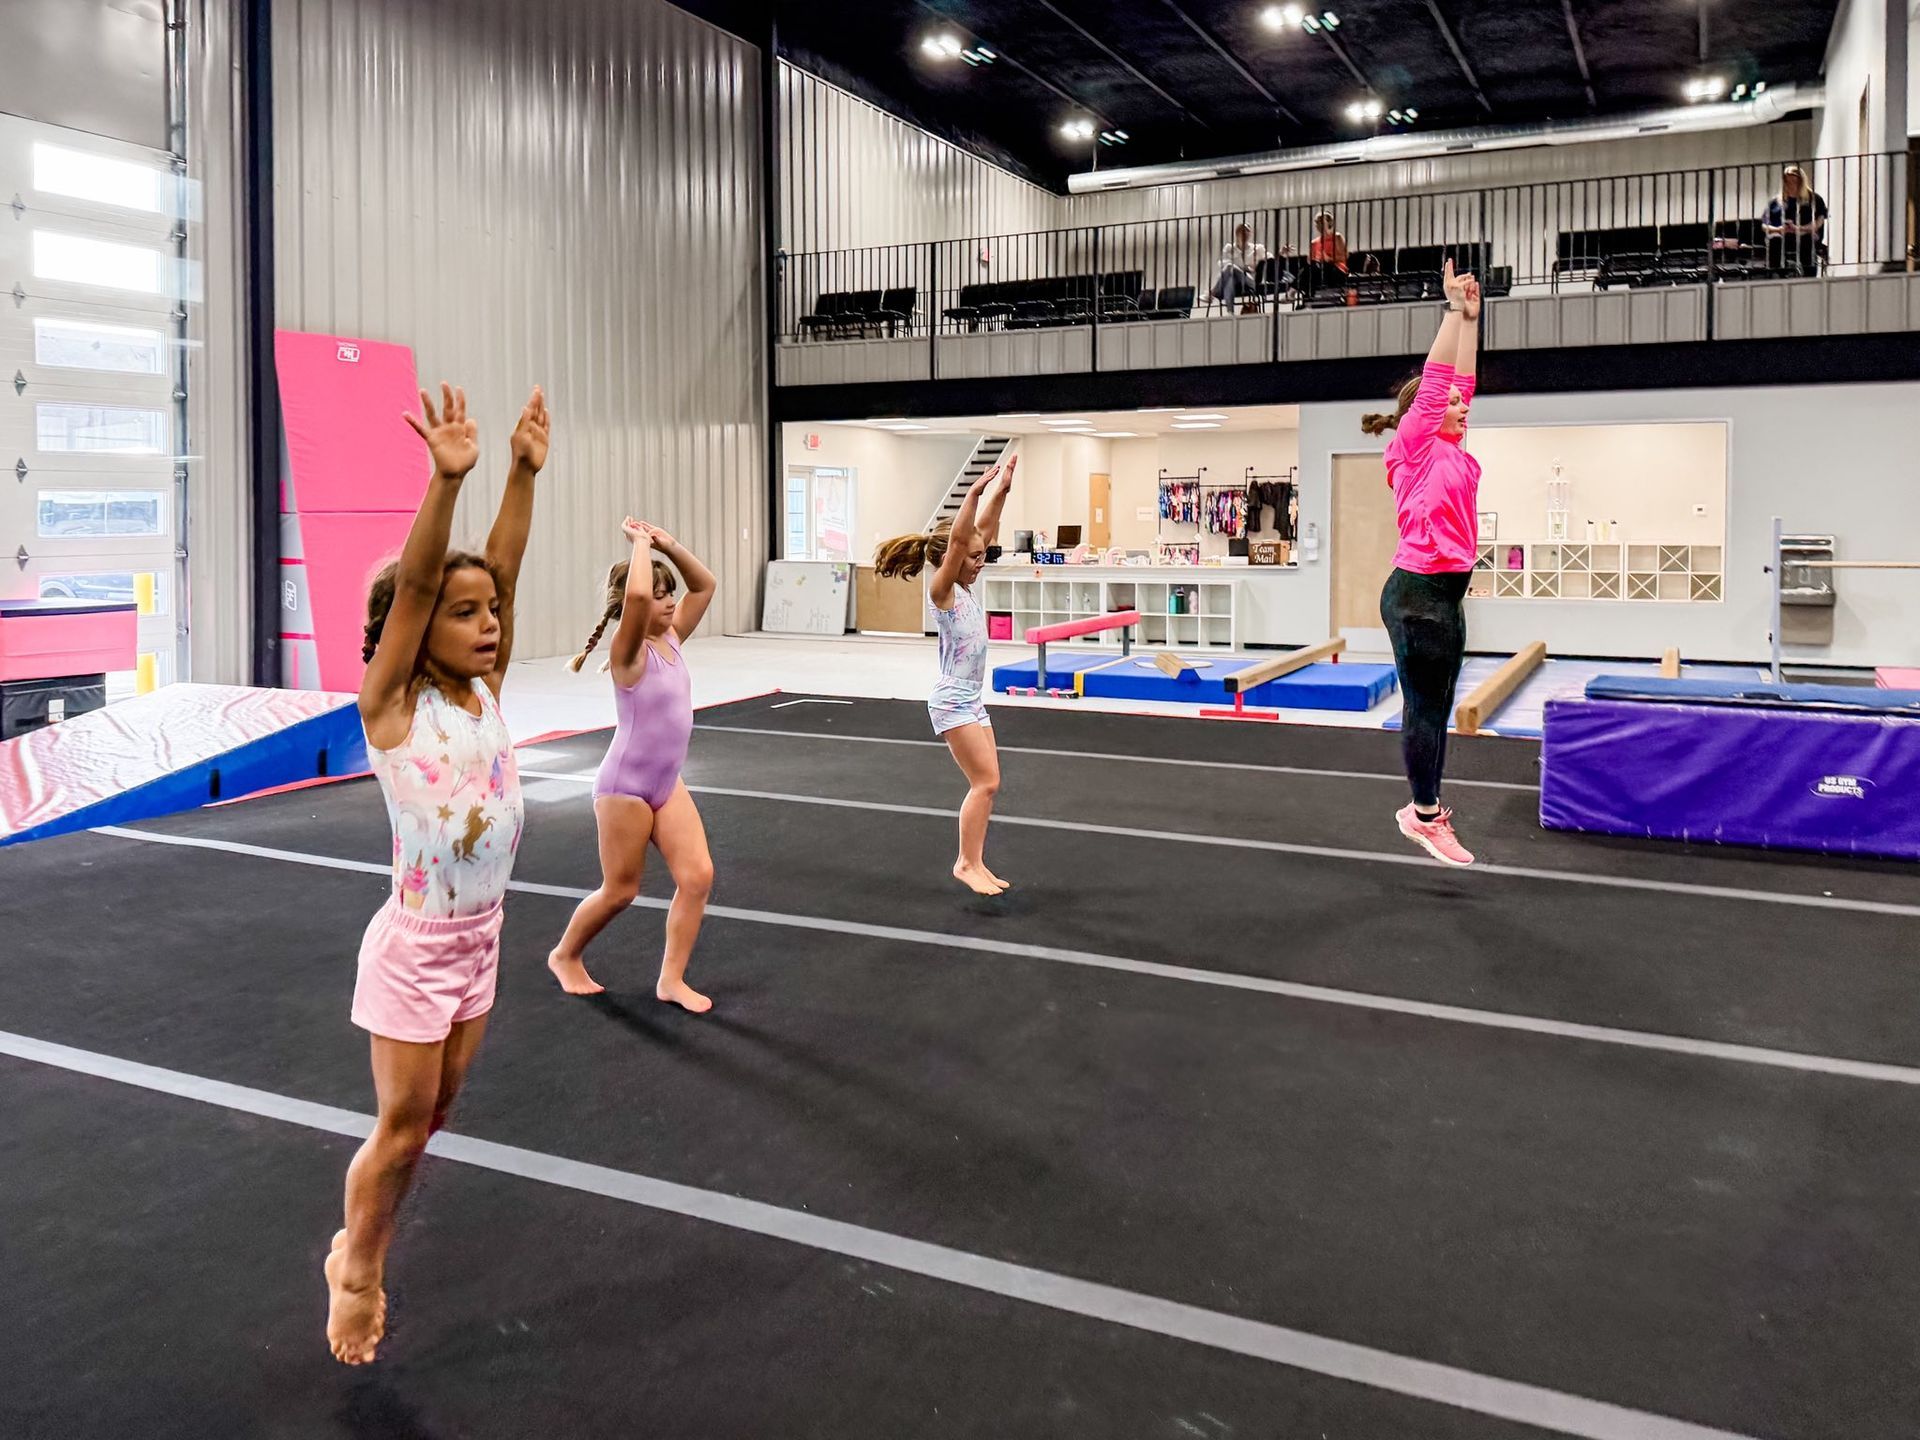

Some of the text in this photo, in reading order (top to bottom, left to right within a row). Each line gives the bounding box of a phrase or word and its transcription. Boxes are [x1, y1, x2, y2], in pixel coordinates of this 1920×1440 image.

[1252, 544, 1275, 553] Team
[1254, 554, 1275, 564] Mail
[1824, 776, 1857, 786] US GYM
[1818, 783, 1864, 798] PRODUCTS
